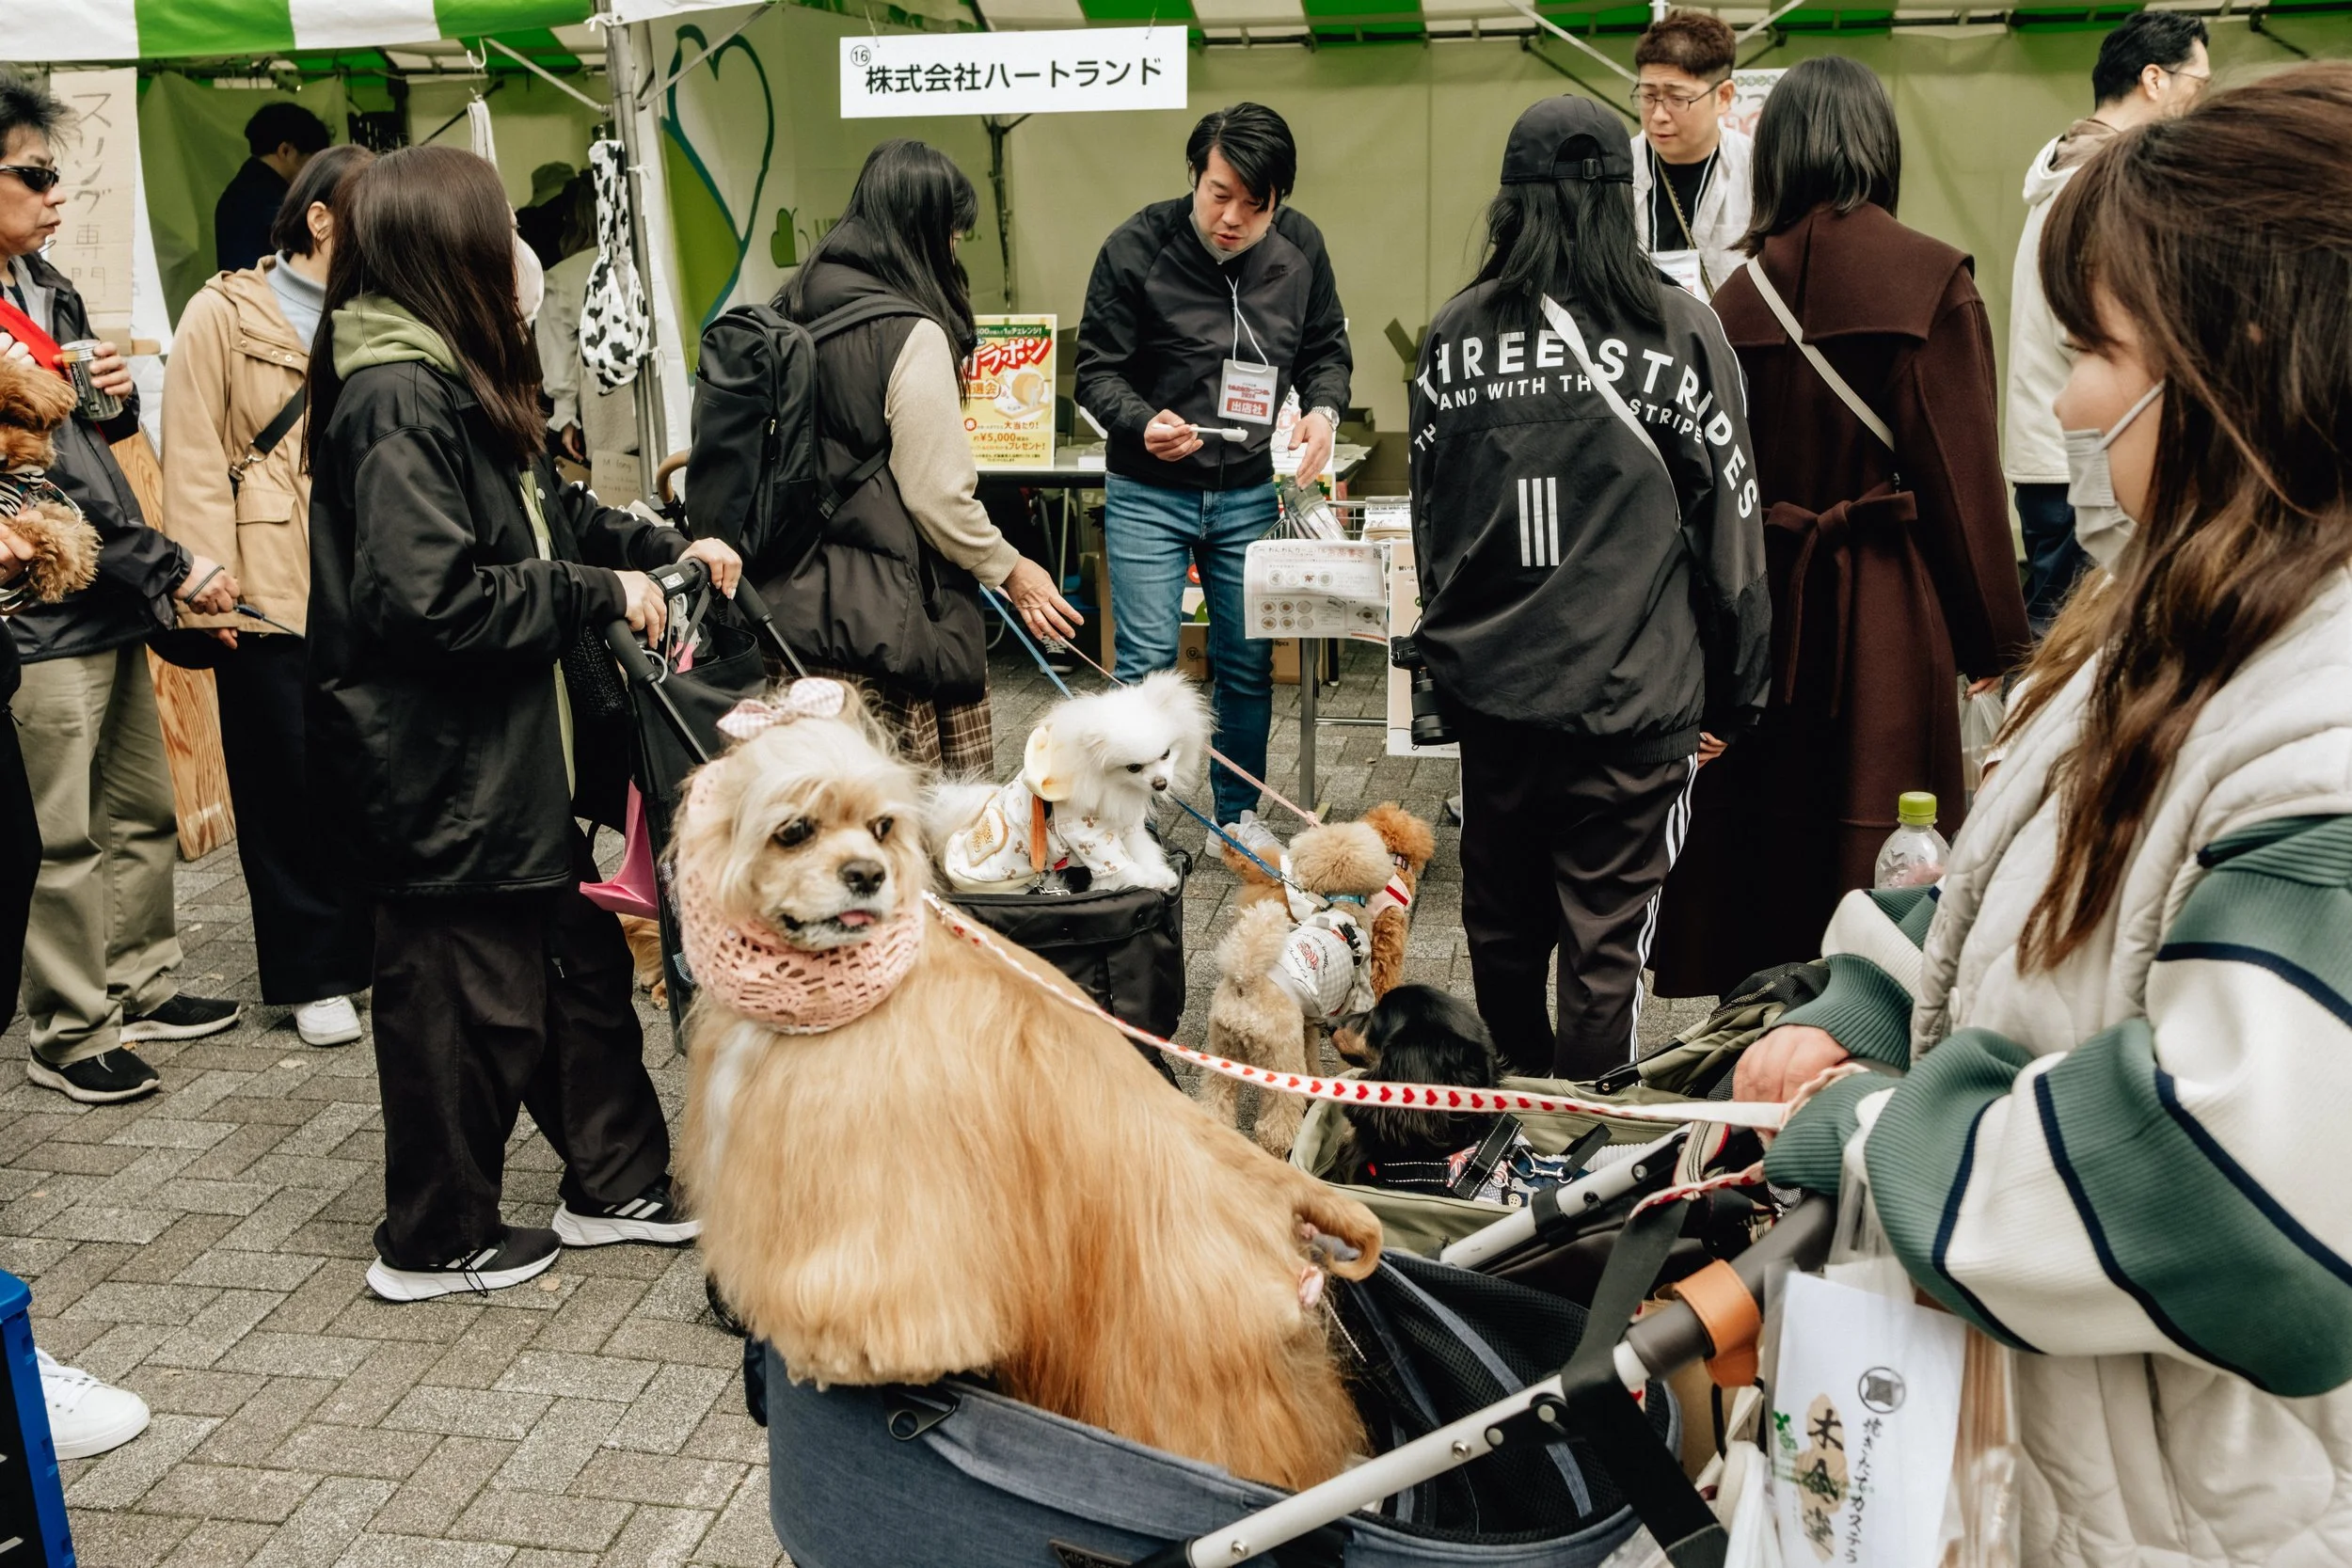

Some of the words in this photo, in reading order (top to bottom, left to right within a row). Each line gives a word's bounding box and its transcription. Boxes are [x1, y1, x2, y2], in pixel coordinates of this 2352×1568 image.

[852, 48, 869, 63] 16
[865, 57, 1162, 94] 株式会社ハートランド
[72, 93, 112, 309] スリング専門
[1414, 423, 1437, 451] TH
[1439, 387, 1477, 411] AND
[1487, 377, 1546, 401] WITH
[1559, 373, 1592, 392] TH
[1629, 398, 1702, 444] STRIPE
[1417, 329, 1565, 405] THREE
[1595, 339, 1757, 518] STRIDES
